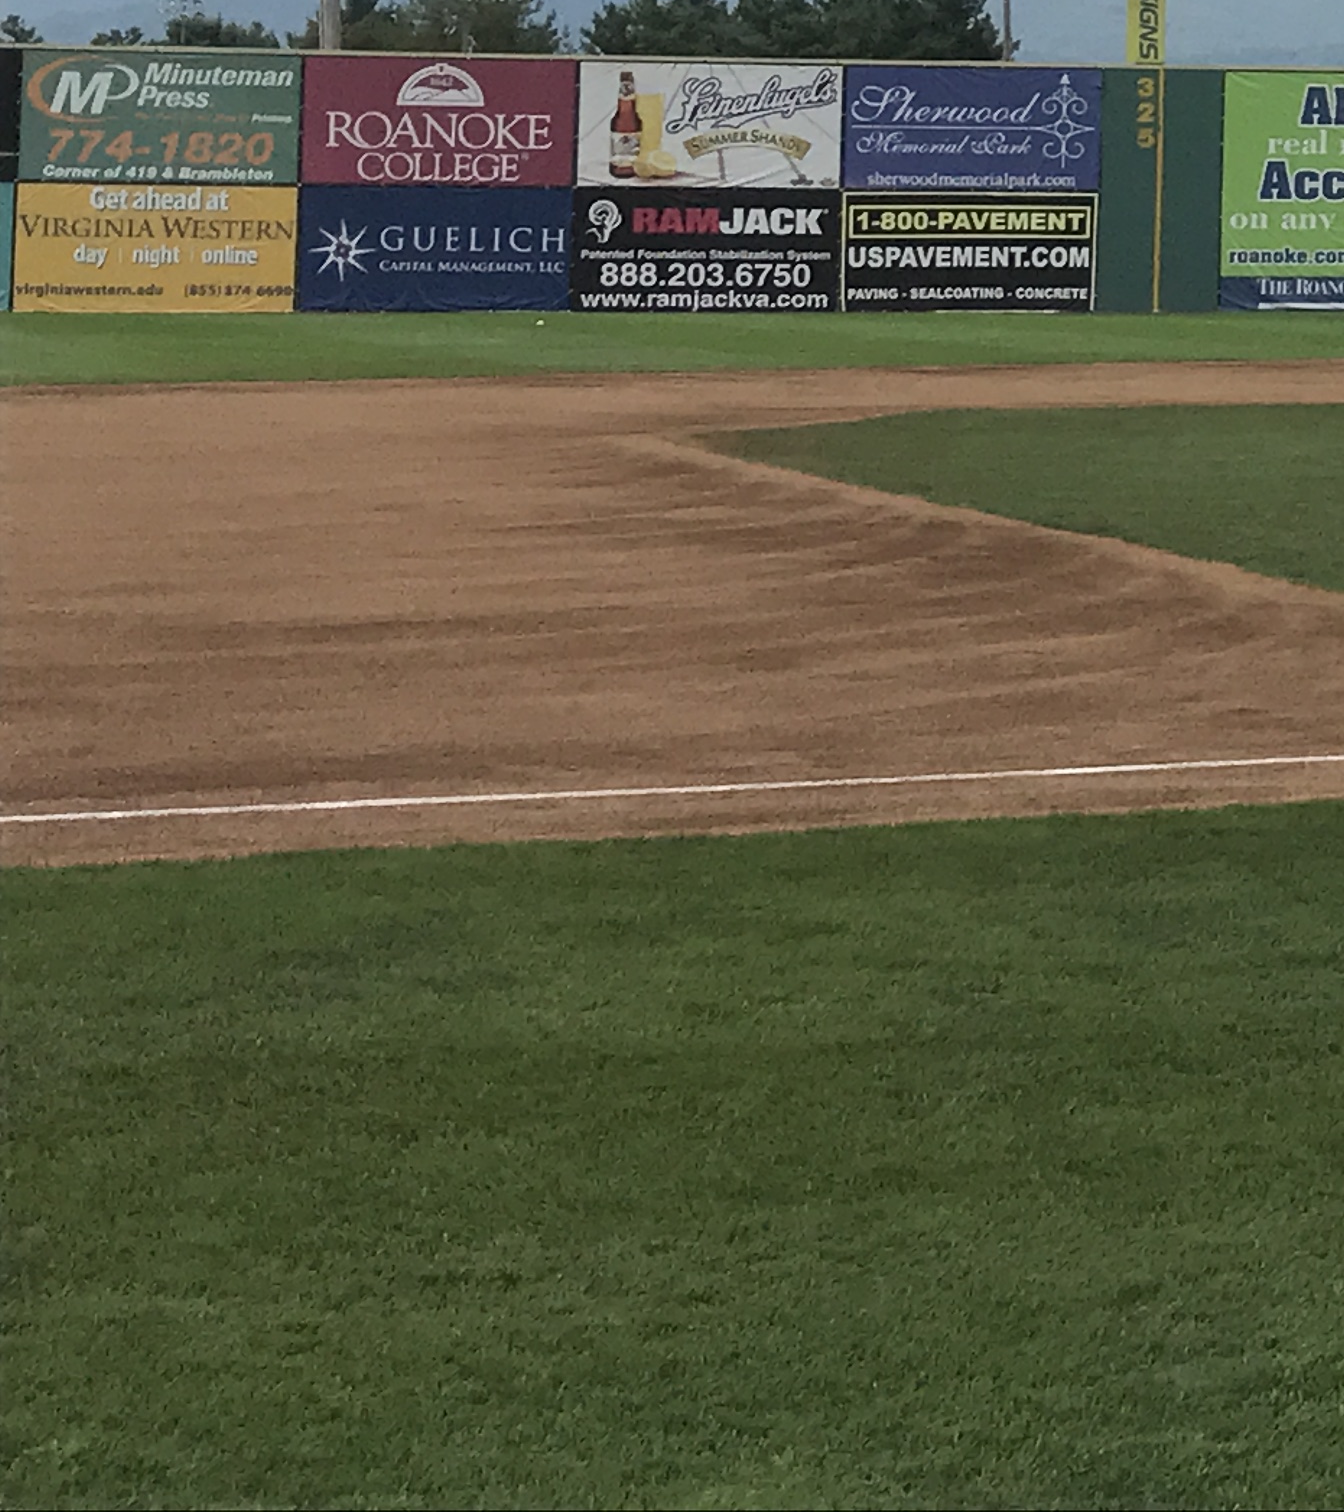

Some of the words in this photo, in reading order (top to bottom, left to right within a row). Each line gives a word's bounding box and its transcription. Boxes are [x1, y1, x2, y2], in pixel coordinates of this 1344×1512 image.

[144, 62, 294, 87] Minuteman
[137, 86, 210, 108] Press
[666, 68, 838, 134] Leinenkugel's
[851, 86, 1041, 122] Sherwood
[325, 111, 553, 150] ROANOKE
[691, 131, 749, 153] SUMMER
[47, 128, 275, 166] 774-1820
[856, 131, 969, 154] Memorial
[971, 132, 1031, 154] Park
[1268, 130, 1327, 155] real
[43, 164, 100, 178] Corner
[103, 165, 121, 178] of
[126, 166, 158, 179] 419
[162, 167, 174, 179] &
[179, 166, 274, 180] Brambleton
[357, 152, 520, 182] COLLEGE
[867, 172, 1076, 188] sherwoodmemorialpark.com
[90, 187, 129, 211] Get
[132, 186, 202, 211] ahead
[205, 189, 230, 212] at
[19, 215, 155, 238] VIRGINIA
[161, 216, 294, 240] WESTERN
[632, 207, 823, 235] RAMJACK
[856, 211, 1085, 231] 1-800-PAVEMENT
[1230, 212, 1268, 230] on
[379, 225, 566, 253] GUELICH
[73, 244, 108, 268] day
[132, 245, 180, 268] night
[202, 246, 258, 265] online
[379, 260, 433, 272] CAPITAL
[539, 261, 565, 273] LLC
[580, 248, 634, 260] Patented
[637, 249, 706, 260] Foundation
[709, 249, 784, 260] Stabilization
[787, 249, 830, 262] System
[848, 246, 1089, 268] USPAVEMENT.COM
[600, 262, 811, 287] 888.203.6750
[15, 282, 164, 297] virginiawestern.edu
[847, 288, 898, 300] PAVING
[910, 287, 1004, 300] SEALCOATING
[1016, 287, 1088, 300] CONCRETE
[1257, 278, 1294, 295] THE
[580, 290, 828, 312] www.ramjackva.com
